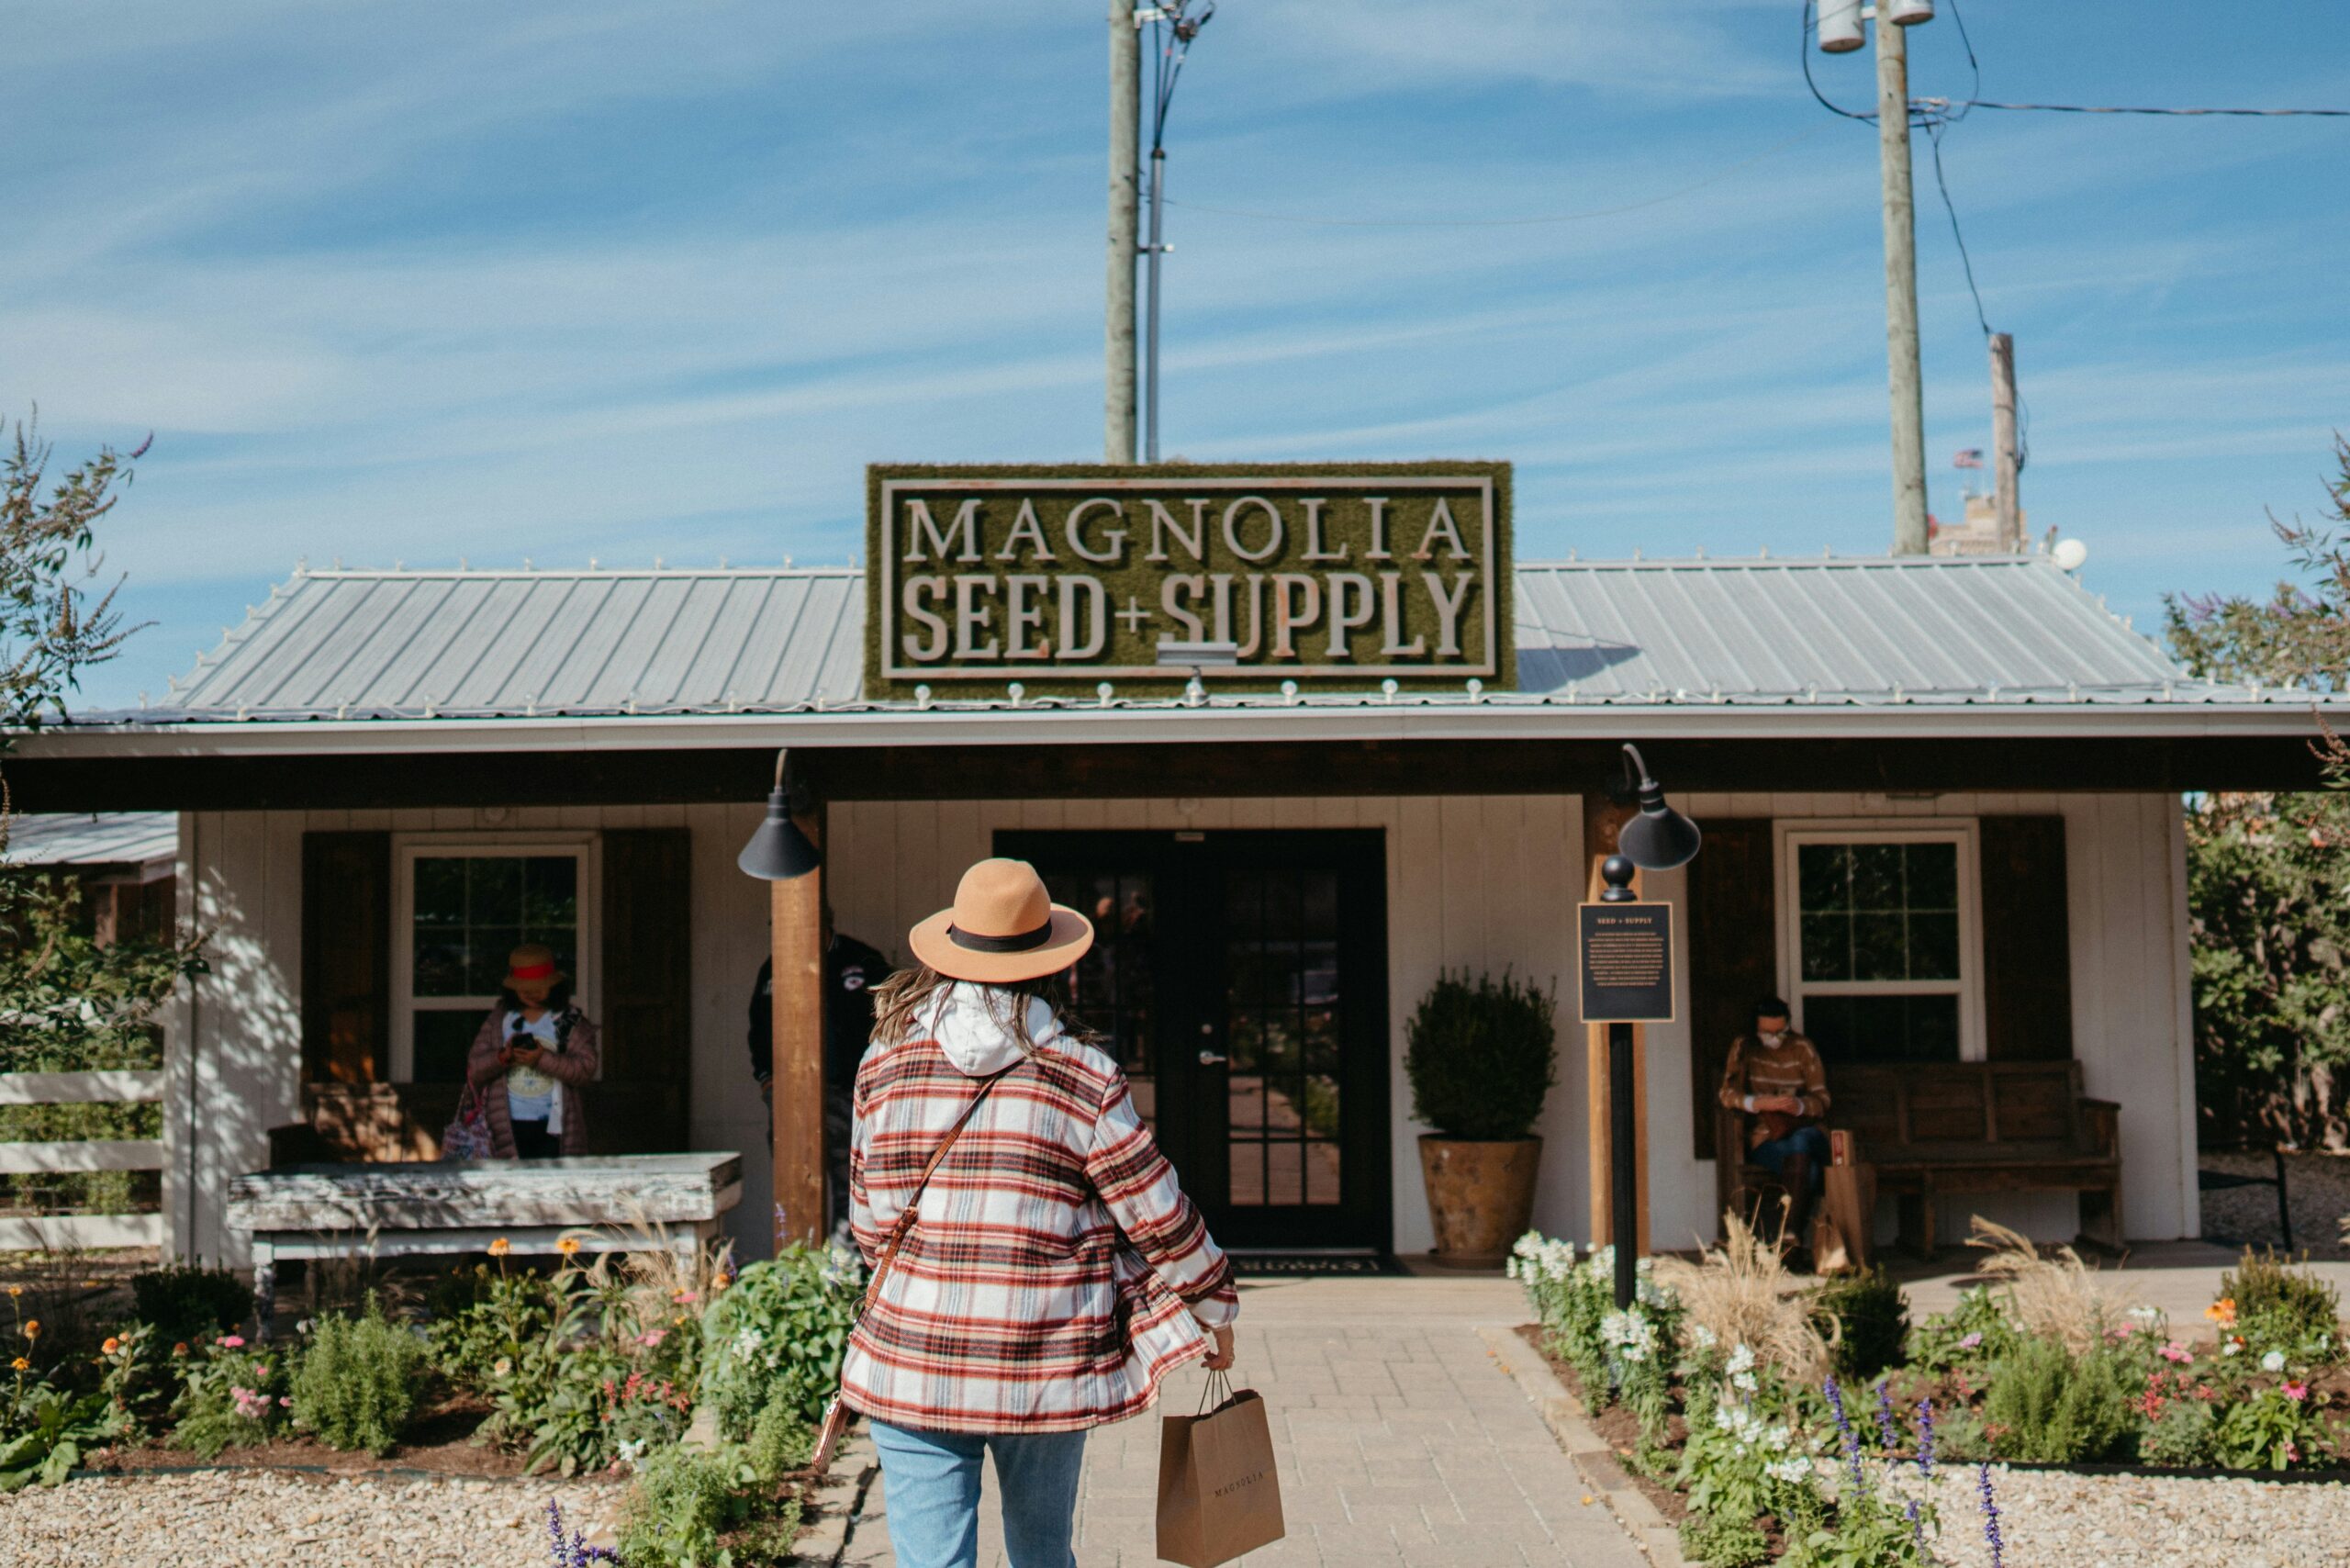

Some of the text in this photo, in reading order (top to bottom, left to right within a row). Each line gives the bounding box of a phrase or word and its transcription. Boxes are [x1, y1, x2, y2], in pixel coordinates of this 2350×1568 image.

[902, 496, 1472, 563] MAGNOLIA
[901, 574, 1104, 661] SEED
[1159, 572, 1474, 658] SUPPLY
